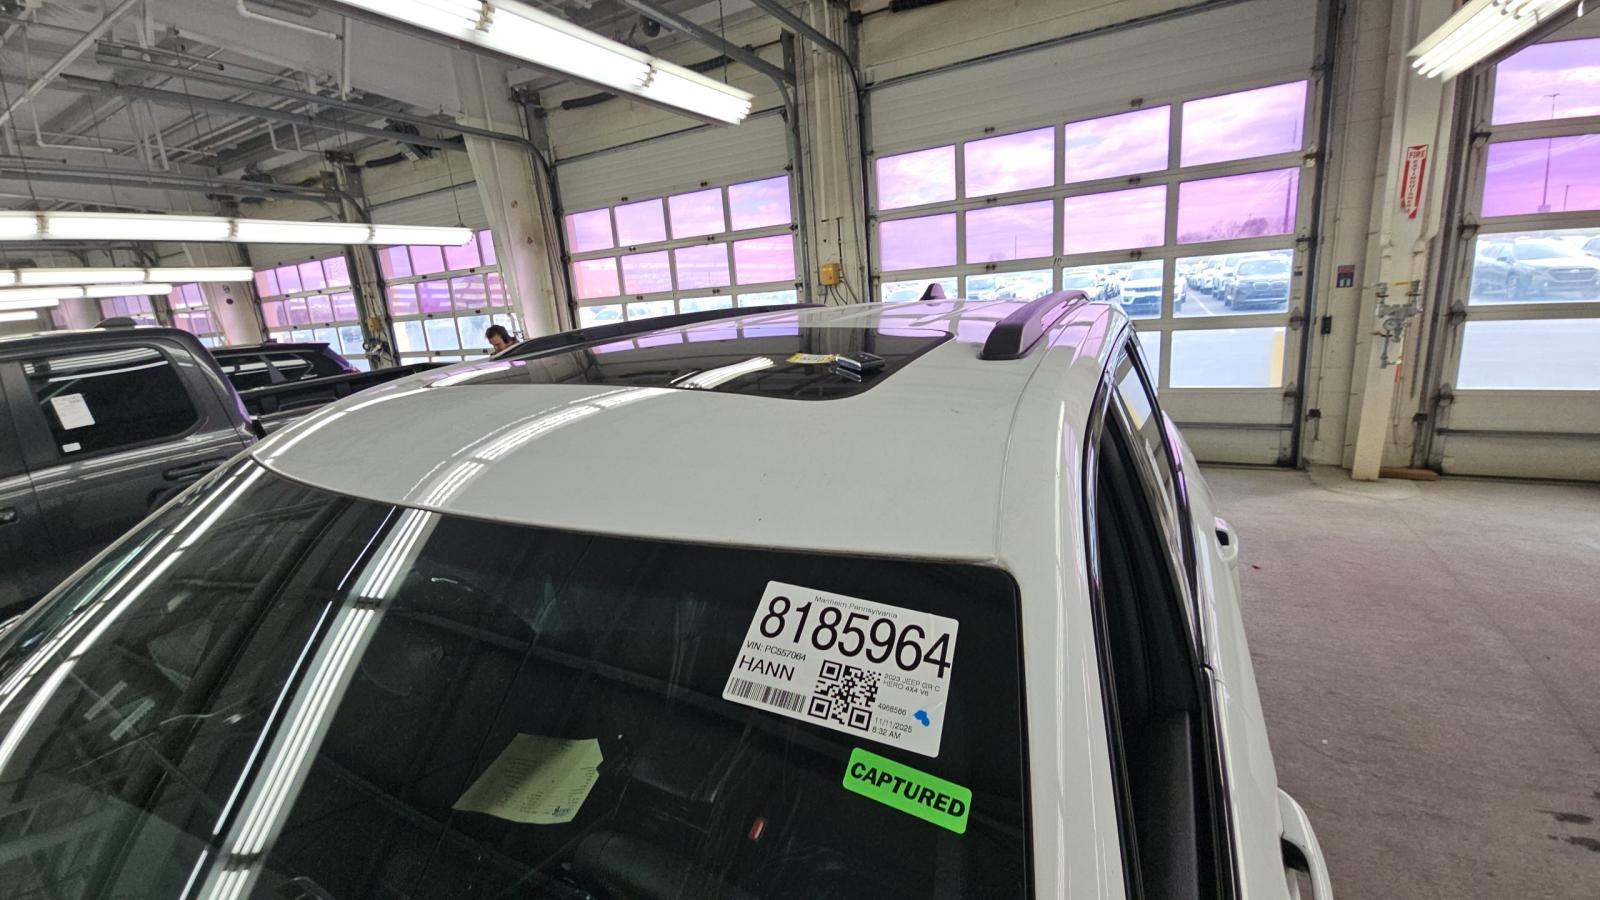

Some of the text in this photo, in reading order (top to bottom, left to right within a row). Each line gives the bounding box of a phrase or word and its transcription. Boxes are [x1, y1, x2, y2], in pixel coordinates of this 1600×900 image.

[849, 603, 898, 619] Pennsylvania
[760, 595, 951, 679] 8185964
[747, 640, 807, 662] VIN: PC557064
[739, 654, 795, 682] HANN
[884, 673, 901, 682] 2023
[902, 677, 921, 687] JEEP
[905, 685, 918, 694] 4X4
[888, 730, 902, 740] AM
[851, 762, 965, 817] CAPTURED
